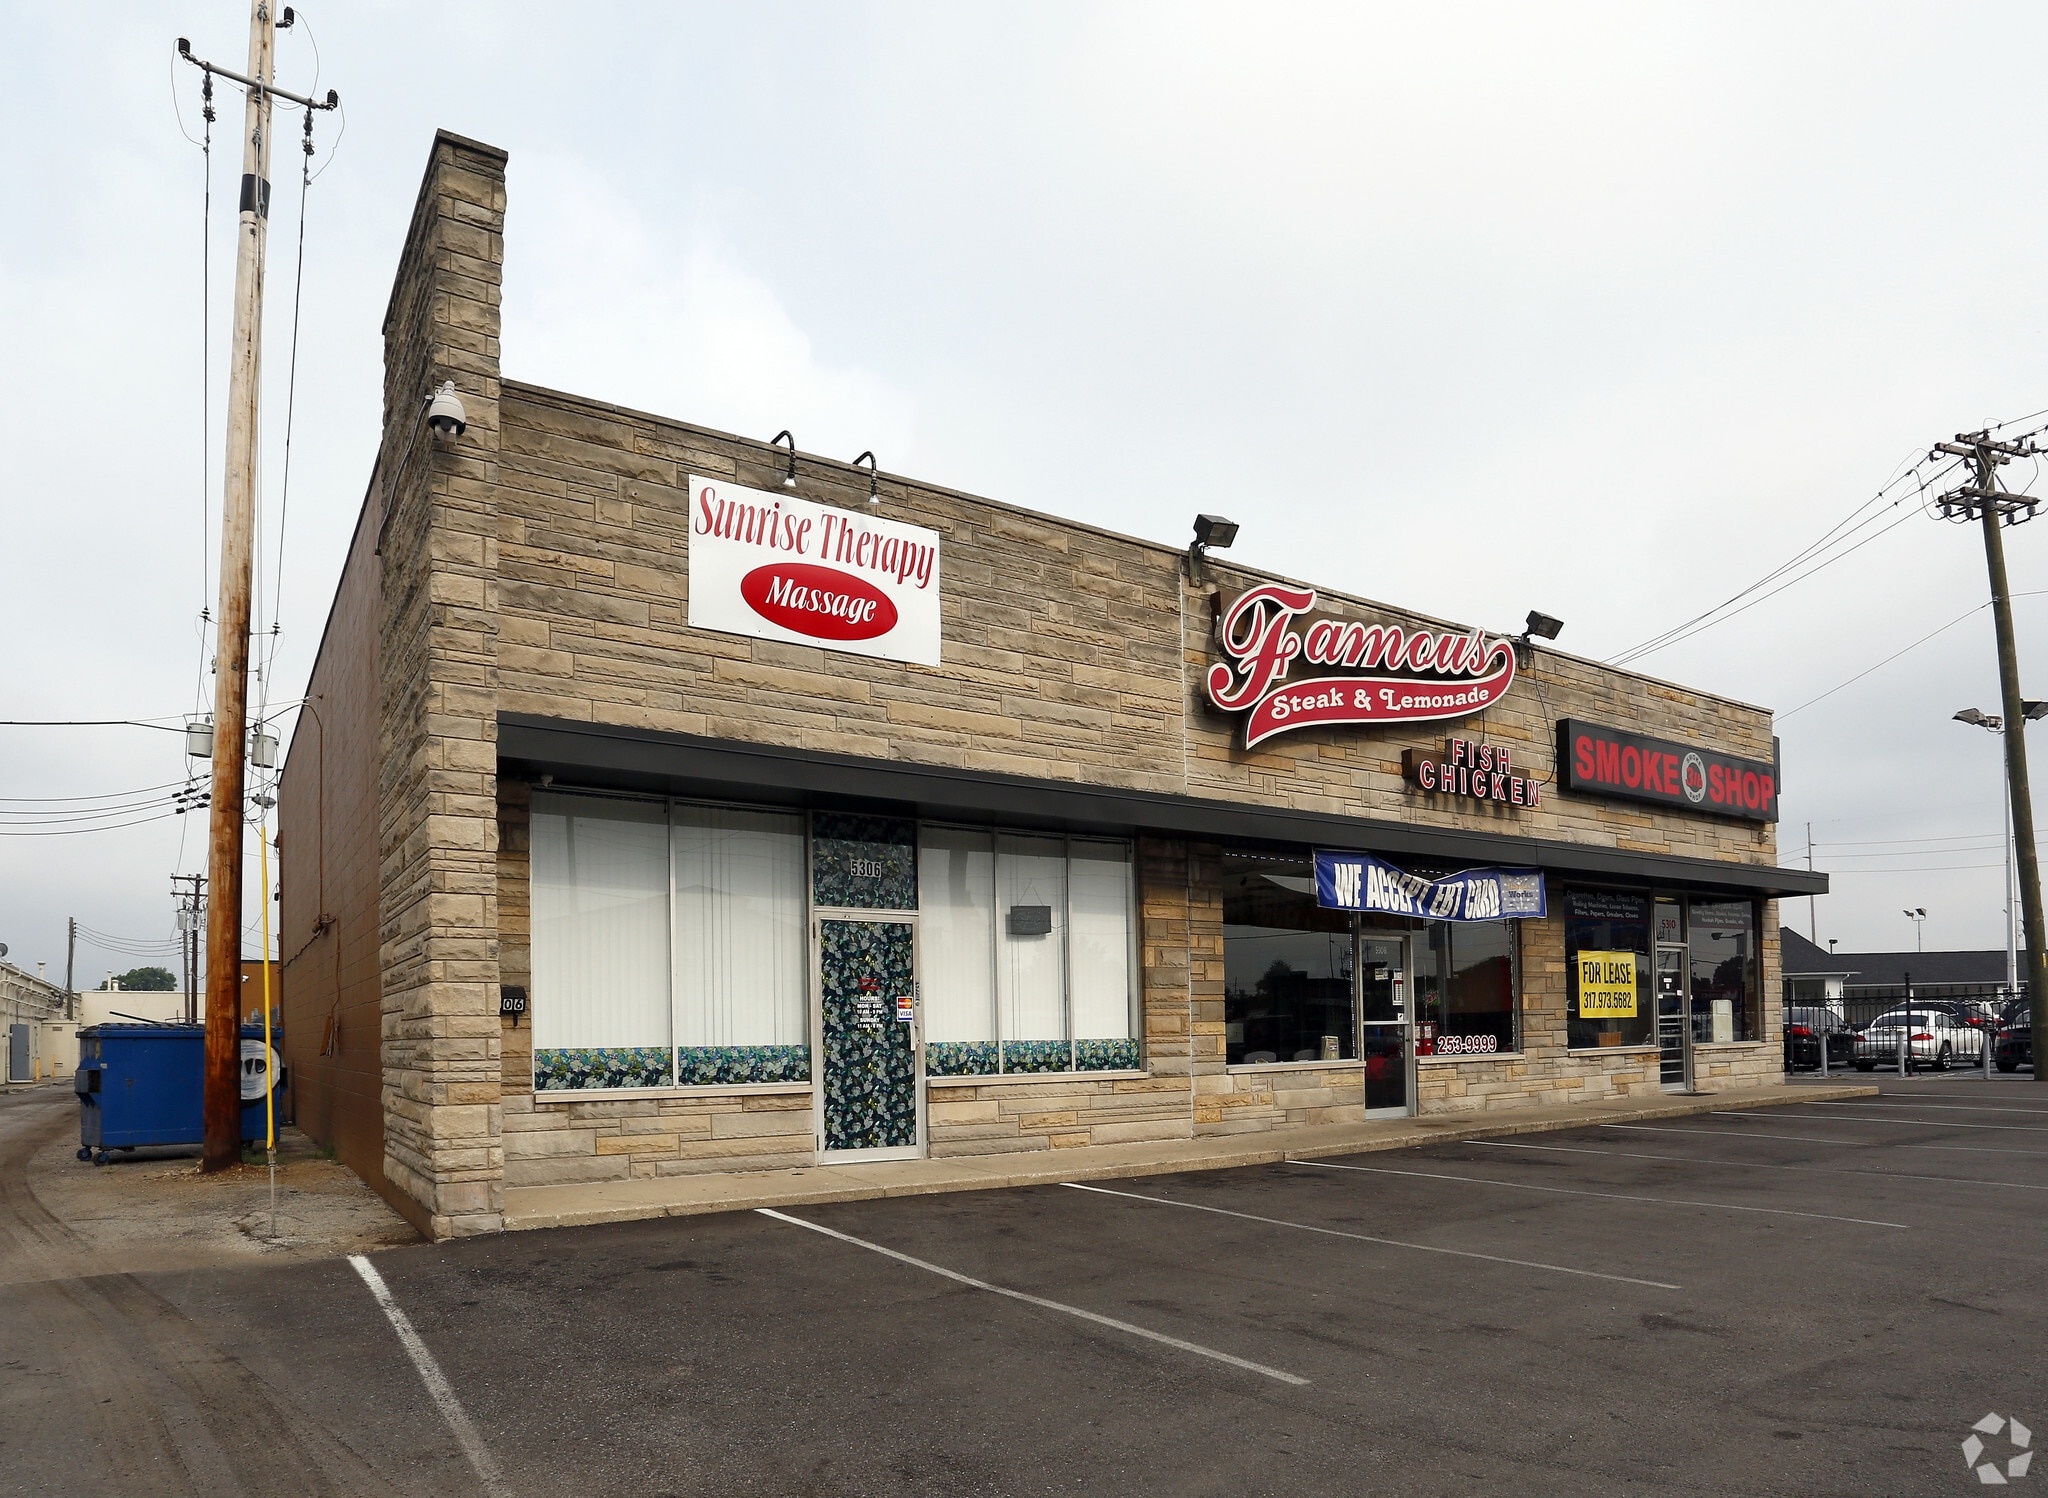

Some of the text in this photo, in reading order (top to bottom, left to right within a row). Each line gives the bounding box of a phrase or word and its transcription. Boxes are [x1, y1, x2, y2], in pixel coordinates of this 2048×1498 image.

[695, 486, 935, 589] Sunrise Therapy
[765, 576, 877, 625] Massage
[1207, 584, 1497, 711] Famous
[1270, 686, 1490, 720] Steak & Lemonade
[1452, 739, 1511, 774] FISH
[1575, 736, 1680, 796] SMOKE
[1709, 763, 1775, 811] SHOP
[1419, 760, 1541, 807] CHICKEN
[851, 860, 881, 877] 5306
[1334, 863, 1500, 919] WE ACCEPT EBT CARD
[1661, 919, 1676, 929] 5310
[1582, 962, 1632, 984] FOR LEASE
[504, 999, 523, 1010] 06
[1584, 992, 1633, 1008] 317.973.5682
[1438, 1034, 1497, 1054] 253-9999
